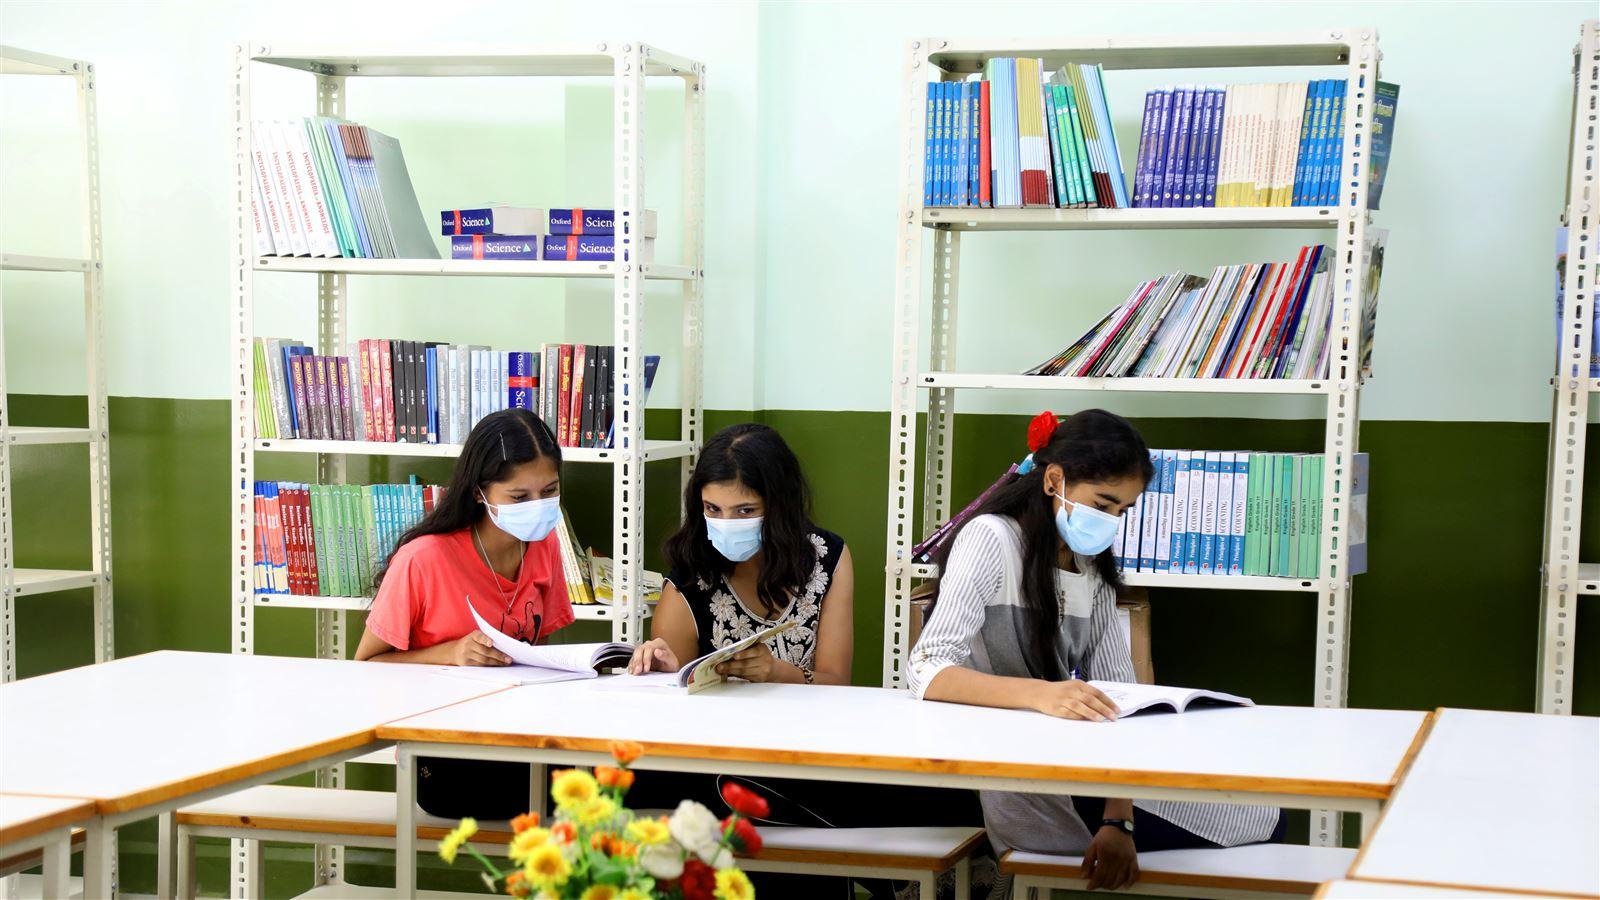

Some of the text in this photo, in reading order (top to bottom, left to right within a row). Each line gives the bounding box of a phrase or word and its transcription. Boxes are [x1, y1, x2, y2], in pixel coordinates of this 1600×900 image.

[256, 151, 271, 195] ENCYCLOPAEDIA
[268, 200, 280, 233] KNOWLEDGE
[286, 150, 313, 233] ENCYCLOPAEDIA KNOWLEDGE
[302, 151, 319, 196] ENCYCLOPAEDIA
[316, 201, 330, 234] KNOWLEDGE
[285, 201, 297, 234] KNOWLEDGE
[462, 216, 484, 227] Science
[485, 242, 521, 253] Science
[1175, 499, 1184, 532] ACCOUNTING
[1190, 498, 1199, 531] ACCOUNTING
[1204, 501, 1213, 534] ACCOUNTING
[1219, 501, 1228, 534] ACCOUNTING
[1234, 501, 1242, 534] ACCOUNTING
